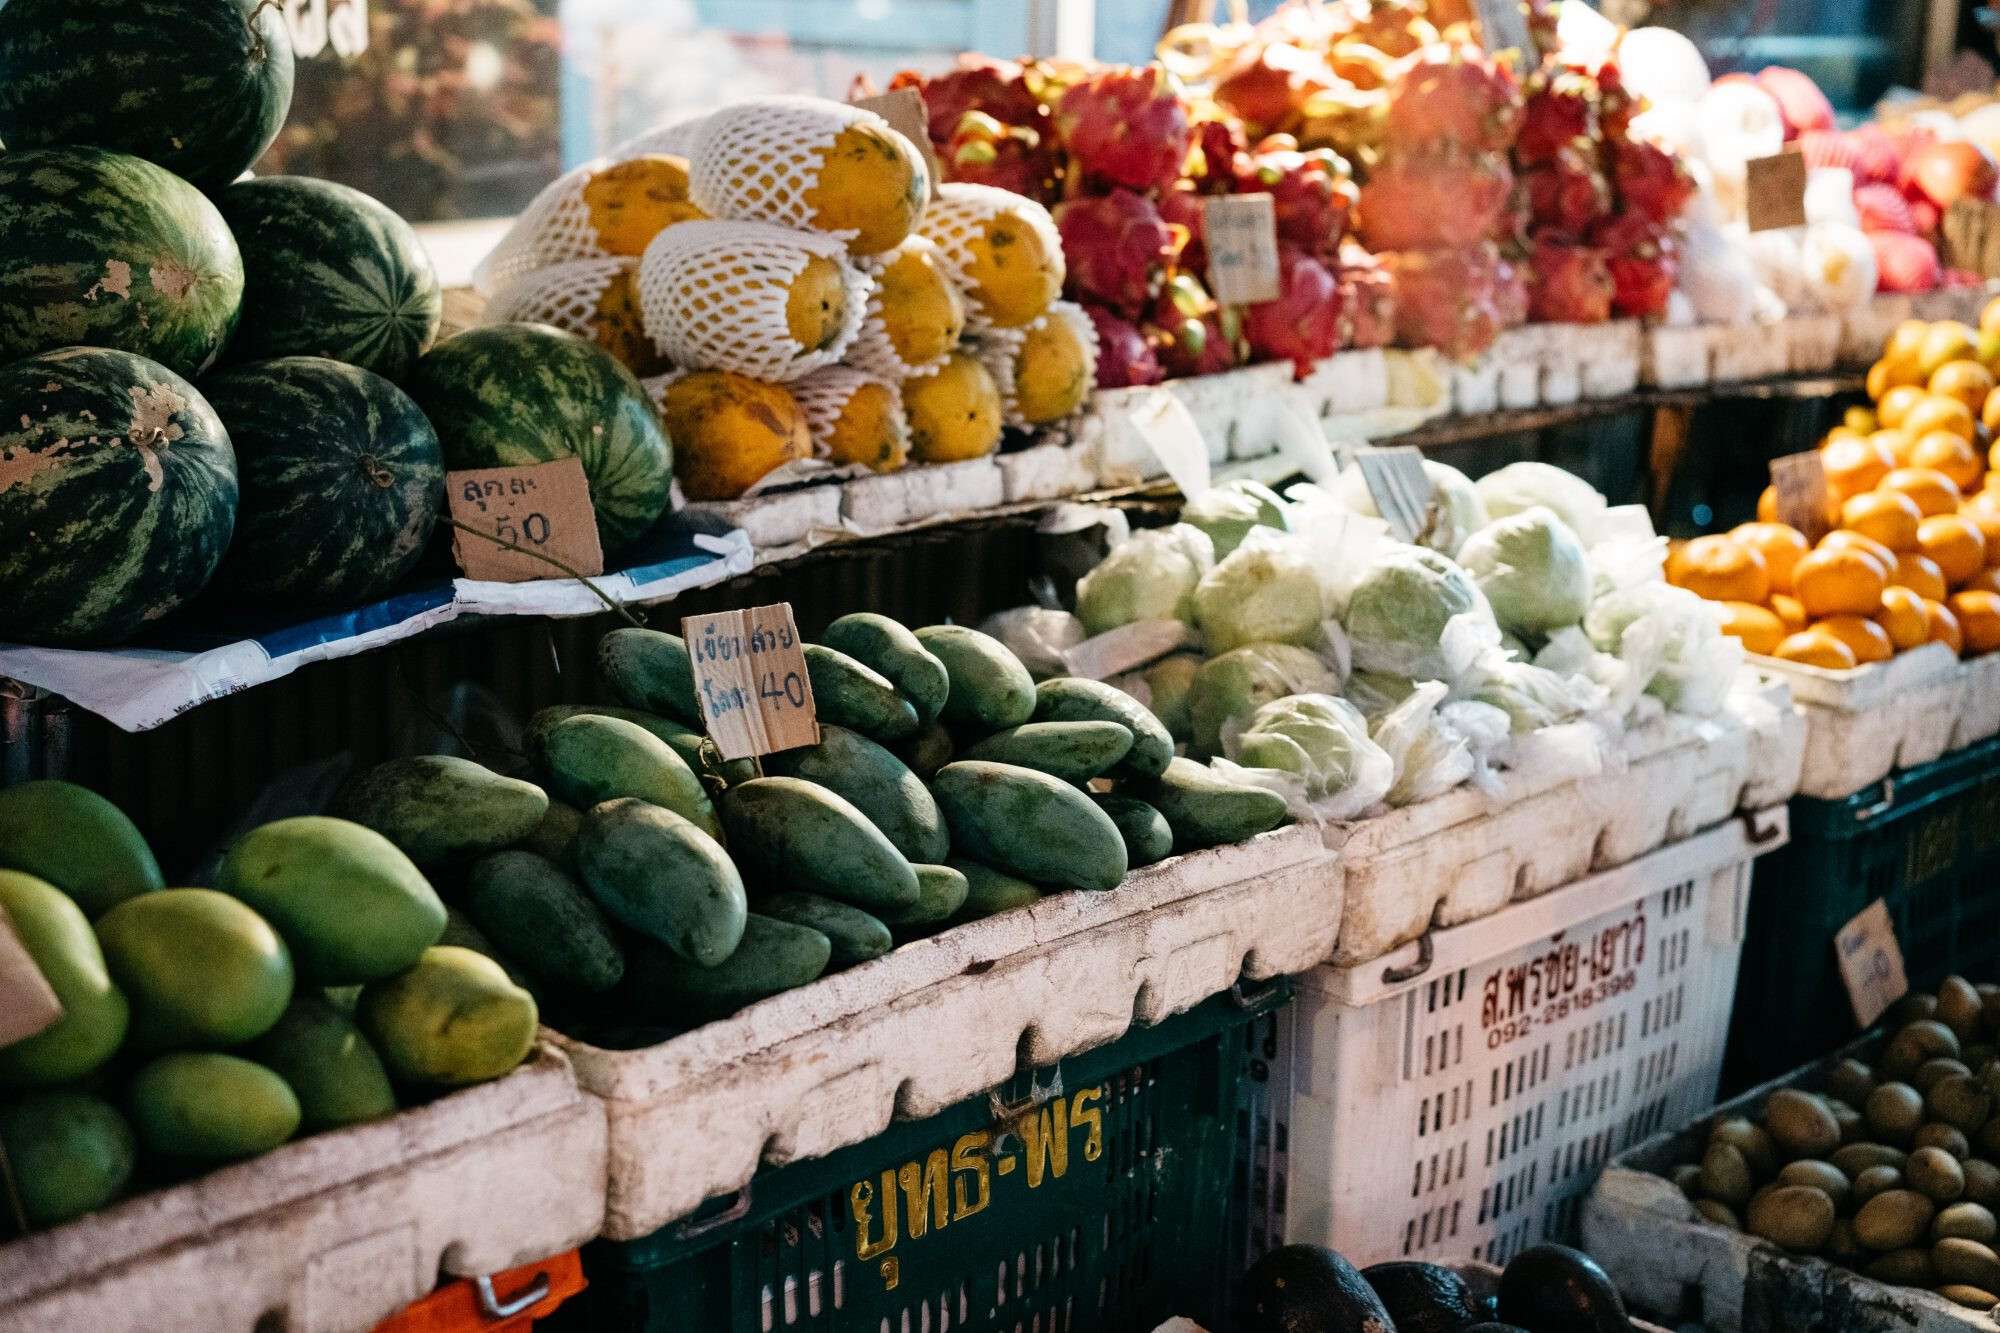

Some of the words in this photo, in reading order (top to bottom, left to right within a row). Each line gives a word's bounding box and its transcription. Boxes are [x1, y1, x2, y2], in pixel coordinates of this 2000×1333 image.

[496, 512, 550, 552] 50
[761, 671, 805, 710] 40
[851, 1086, 1102, 1291] ยุทธ-พร
